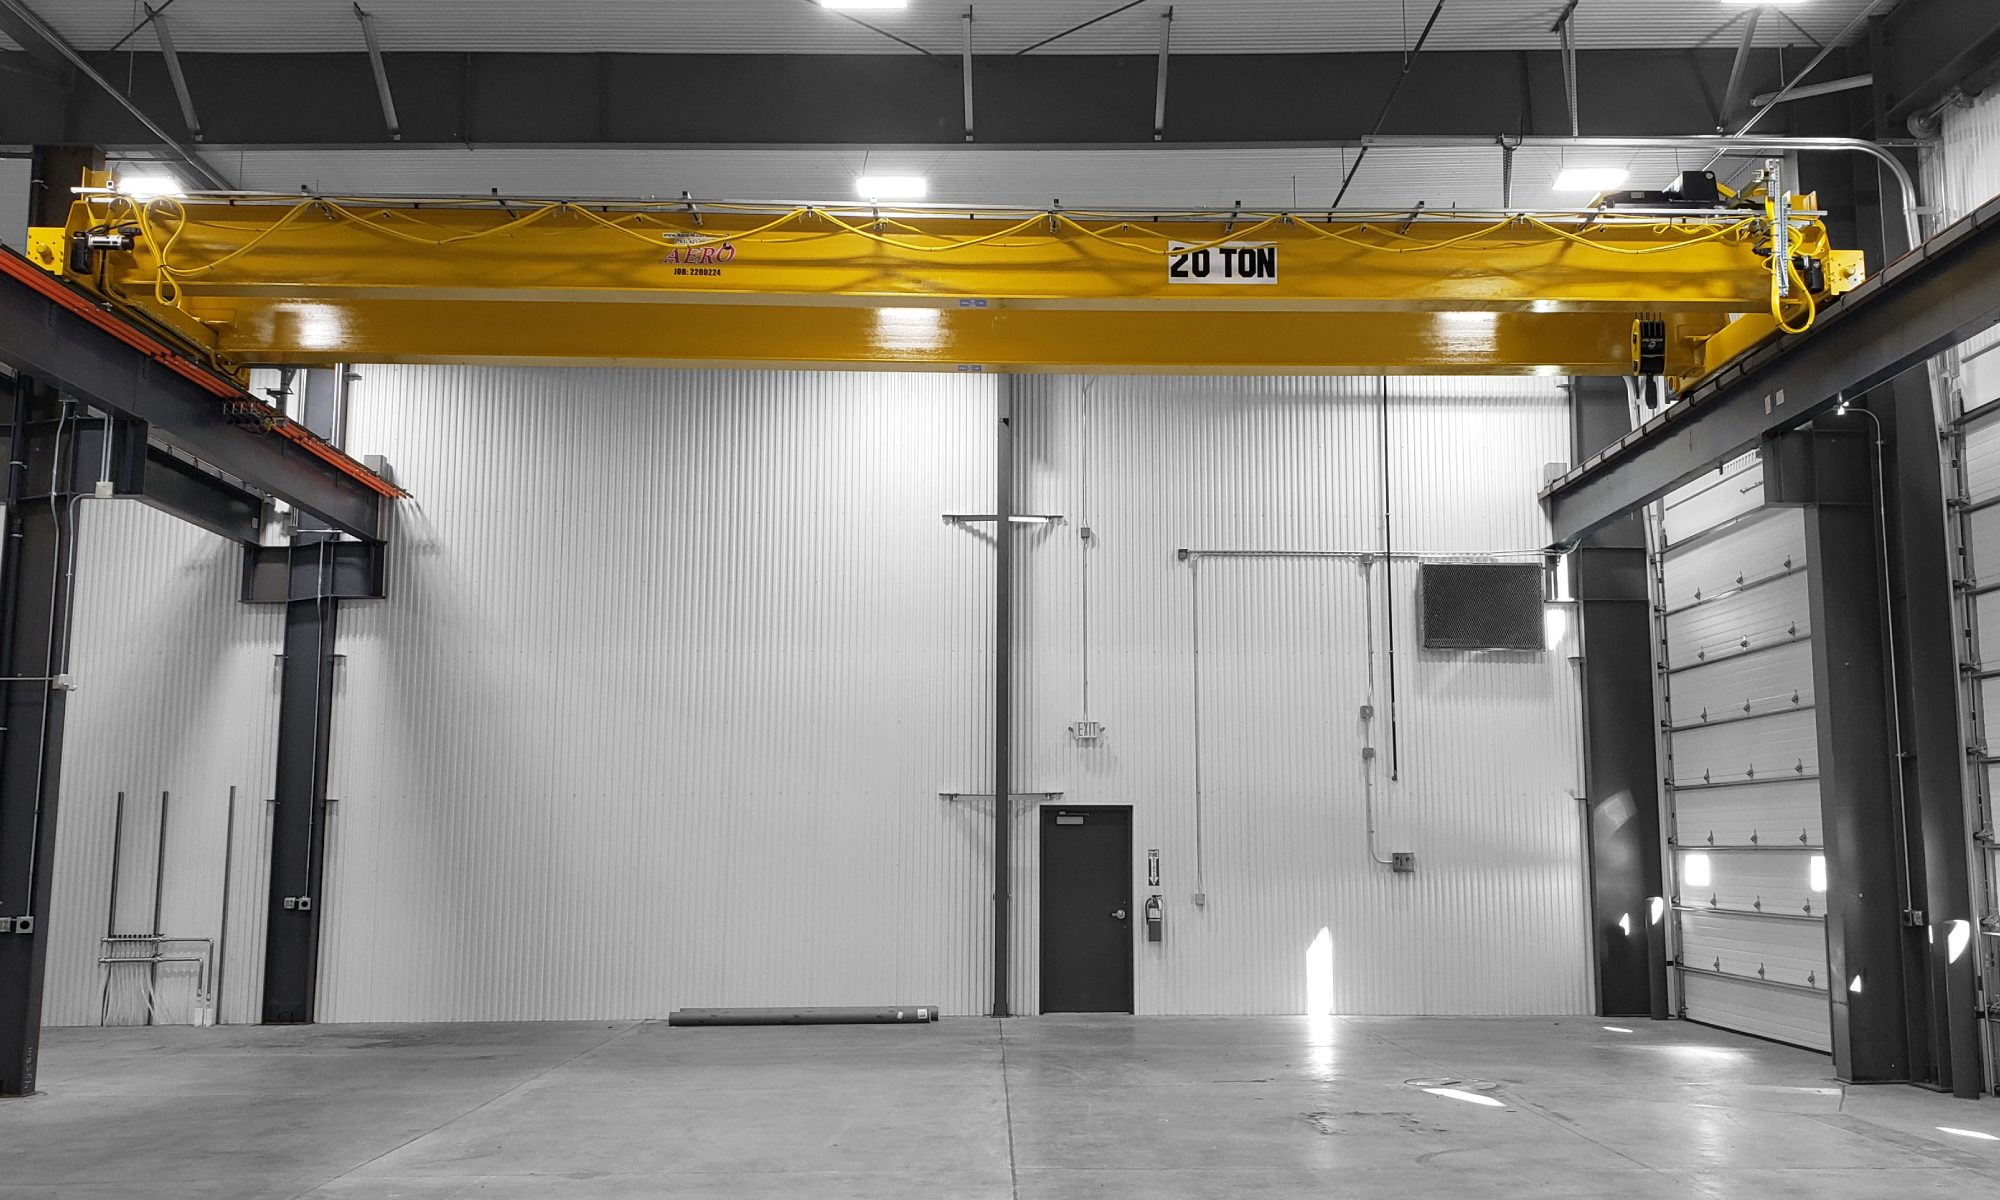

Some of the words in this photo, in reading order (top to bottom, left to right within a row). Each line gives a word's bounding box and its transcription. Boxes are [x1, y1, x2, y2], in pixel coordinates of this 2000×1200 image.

[661, 246, 735, 265] AERO
[1171, 247, 1210, 278] 20
[1219, 248, 1275, 278] TON
[674, 268, 688, 276] JOB:
[690, 268, 721, 276] 2200224
[1077, 721, 1098, 737] EXIT
